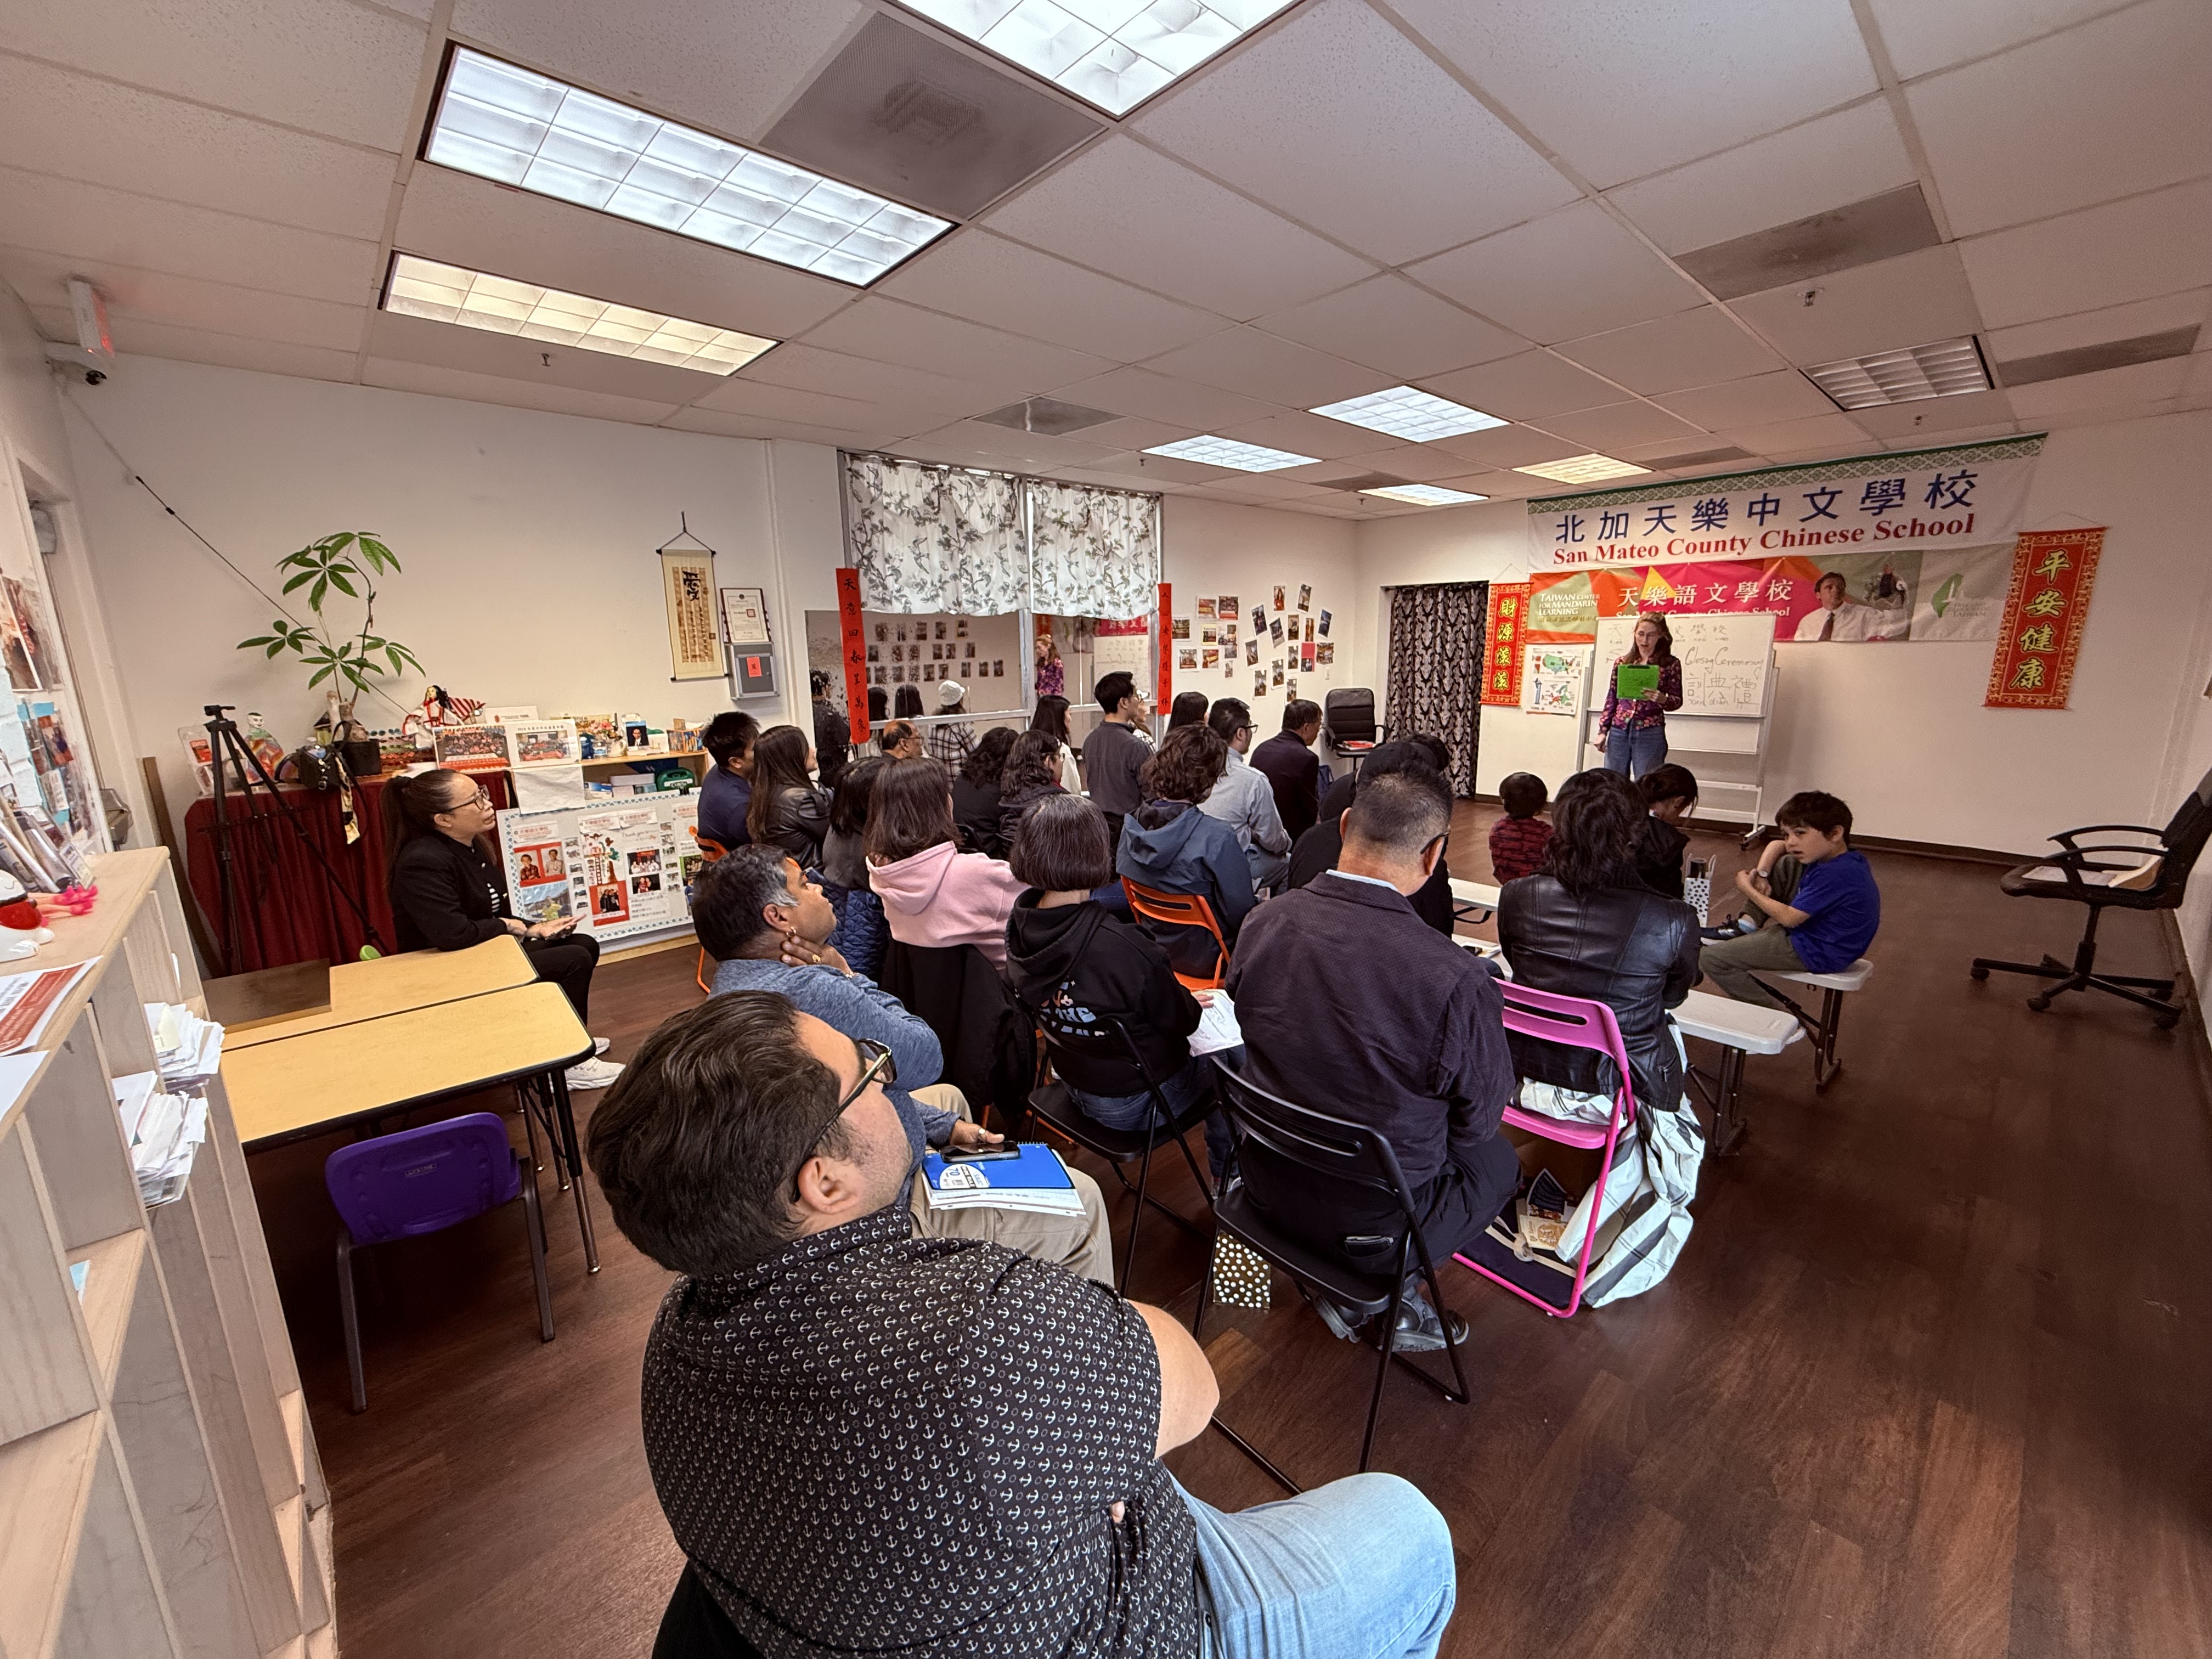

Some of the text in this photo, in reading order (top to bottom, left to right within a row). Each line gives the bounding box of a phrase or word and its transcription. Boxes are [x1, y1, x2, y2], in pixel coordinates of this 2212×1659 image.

[1555, 469, 1978, 544] 北加天樂中文學校
[1554, 513, 1974, 565] San Mateo County Chinese School
[1540, 593, 1575, 602] TAIWAN
[1617, 578, 1793, 607] 天樂語文學校
[1538, 608, 1578, 616] LEARNING
[1552, 600, 1598, 608] MANDARIN
[2010, 549, 2072, 690] 平安健康
[948, 1167, 961, 1176] 70
